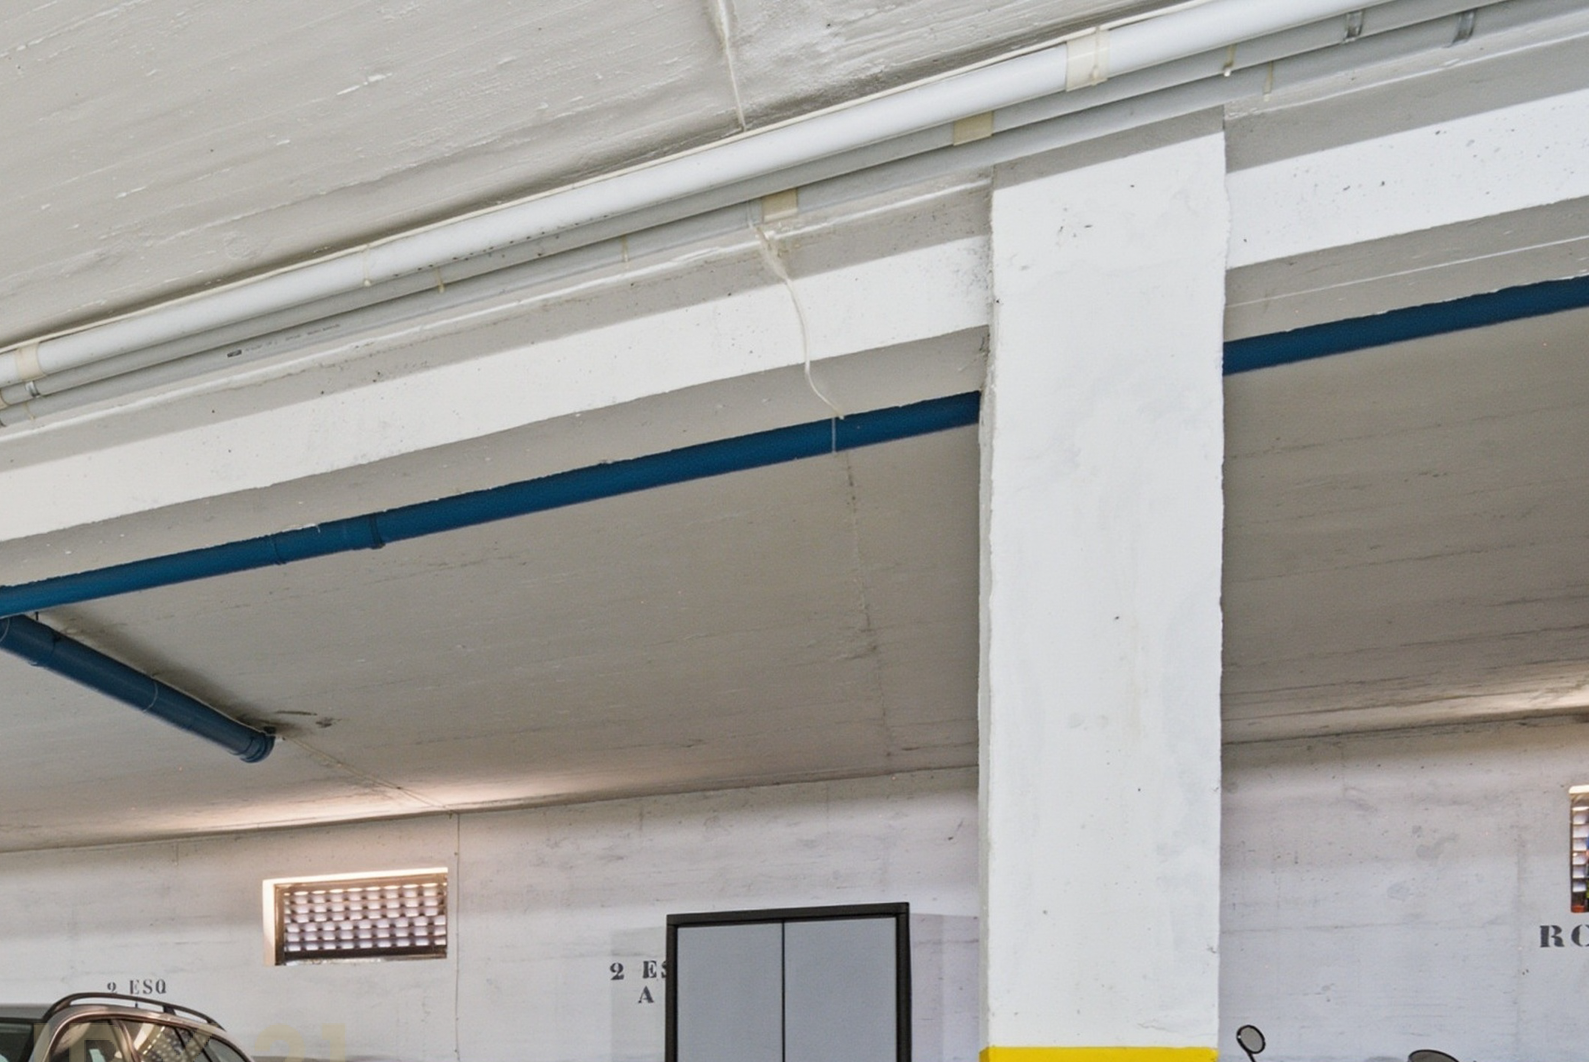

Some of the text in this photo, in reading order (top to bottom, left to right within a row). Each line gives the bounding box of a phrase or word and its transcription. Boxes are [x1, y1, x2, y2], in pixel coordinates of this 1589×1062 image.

[610, 962, 624, 980] 2
[129, 979, 167, 995] ESQ
[638, 985, 654, 1004] A
